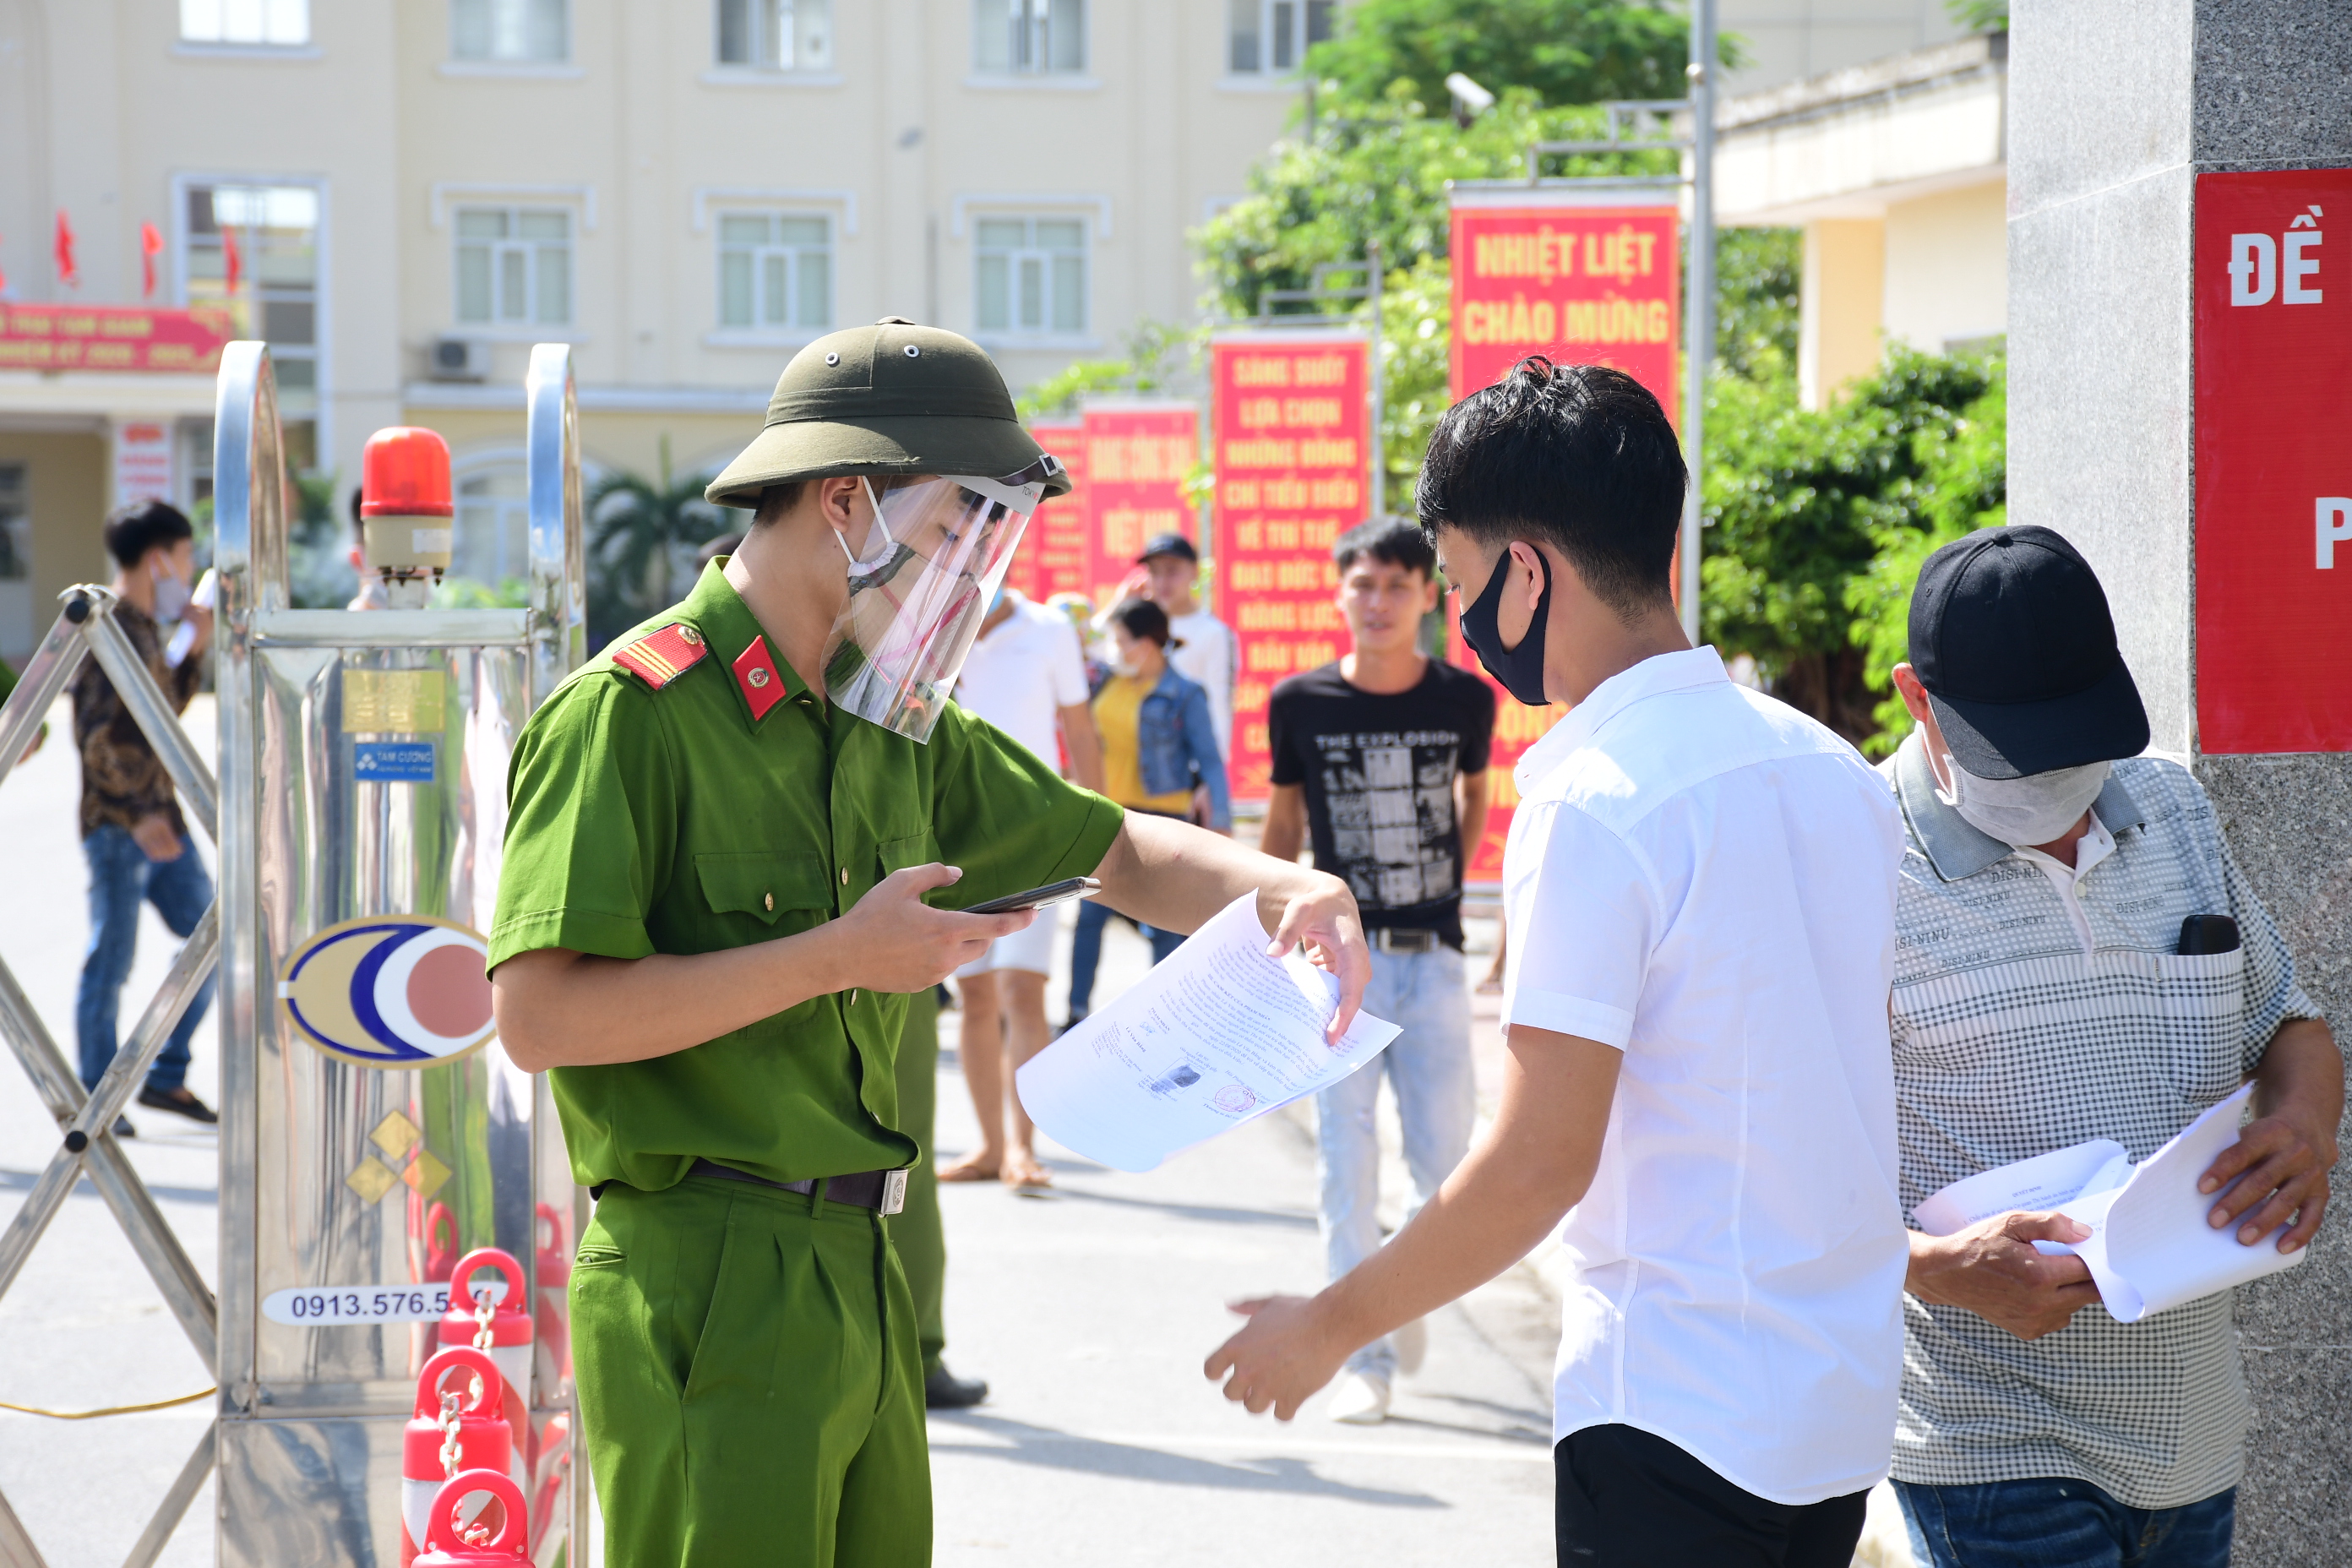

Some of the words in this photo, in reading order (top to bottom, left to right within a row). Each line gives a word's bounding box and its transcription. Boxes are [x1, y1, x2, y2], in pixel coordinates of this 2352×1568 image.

[1474, 224, 1577, 287] NHIỆT
[1583, 222, 1658, 287] LIỆT
[2228, 204, 2324, 307] ĐỀ
[1463, 291, 1556, 346] CHÀO
[1565, 289, 1669, 346] MỪNG
[1315, 732, 1352, 750] THE
[1353, 729, 1460, 750] EXPLOSION
[1895, 927, 1951, 951] ISI-NINU
